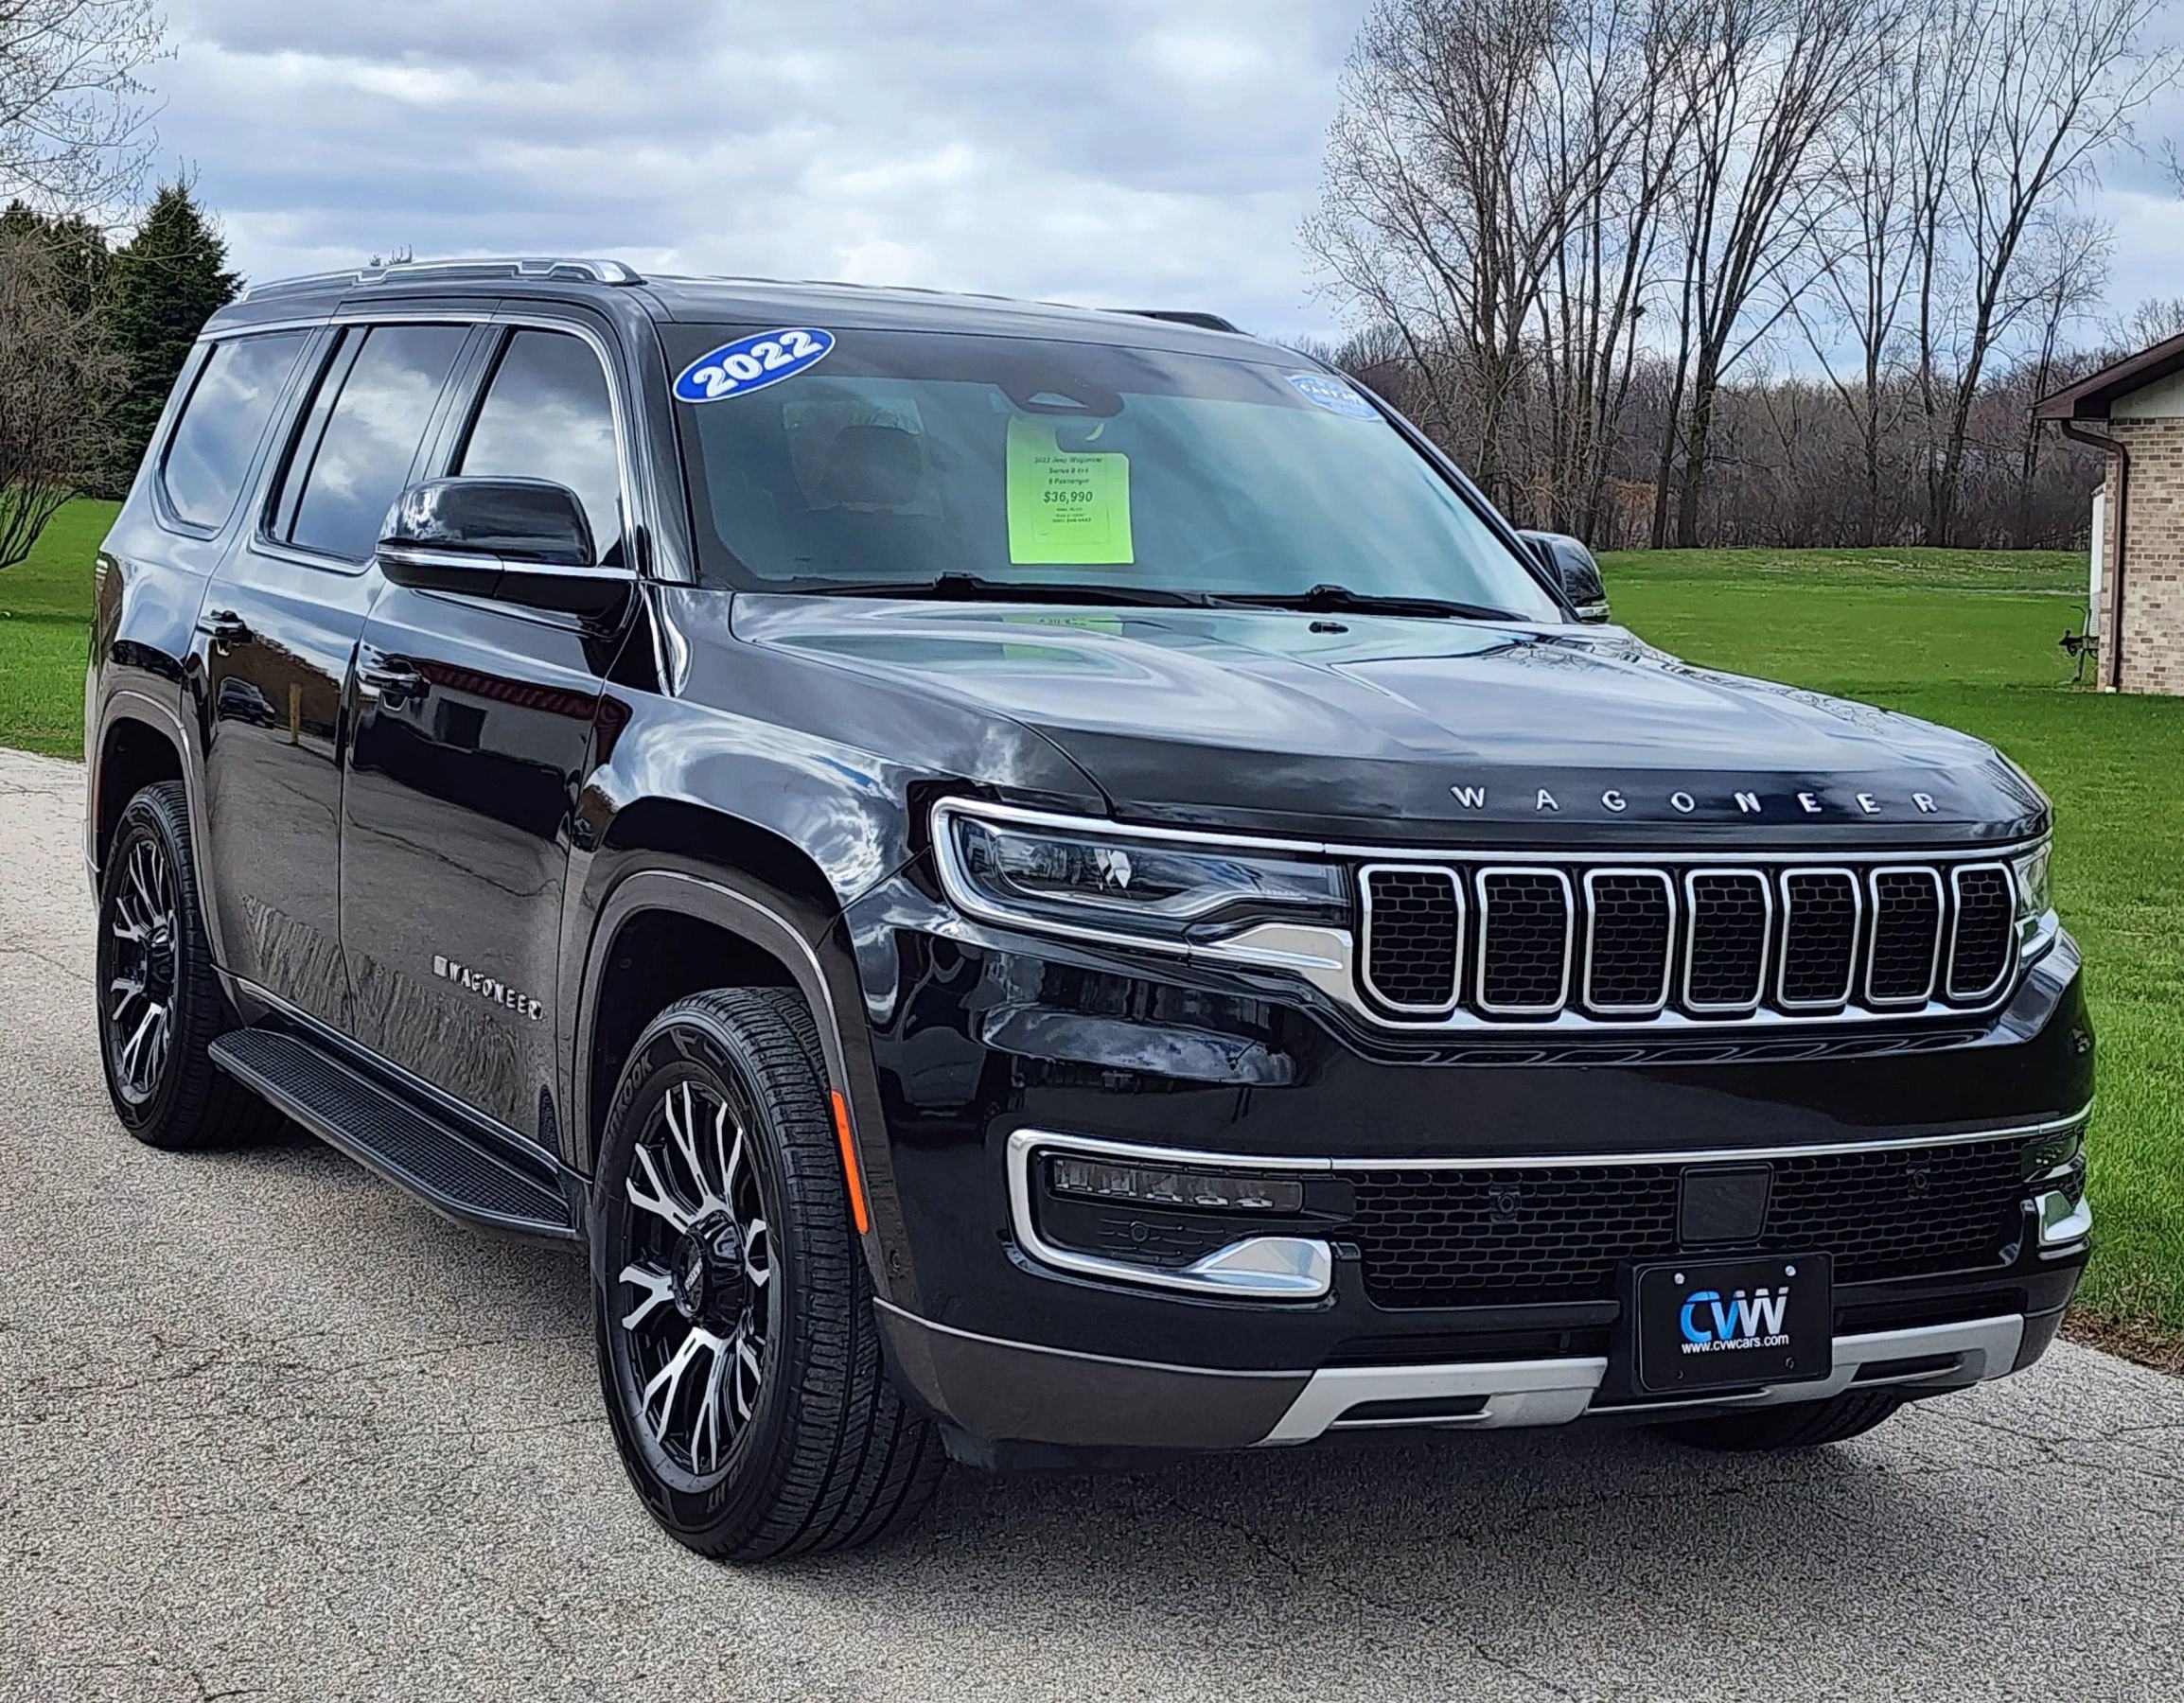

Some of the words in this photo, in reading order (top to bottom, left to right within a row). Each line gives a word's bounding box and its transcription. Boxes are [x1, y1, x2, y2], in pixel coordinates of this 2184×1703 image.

[693, 331, 824, 397] 2022
[1043, 490, 1093, 504] $36,990
[1452, 784, 1939, 815] WAGONEER
[449, 961, 544, 1021] WAGONEER
[1681, 1287, 1789, 1343] CVW
[1681, 1334, 1789, 1354] www.cvwcars.com
